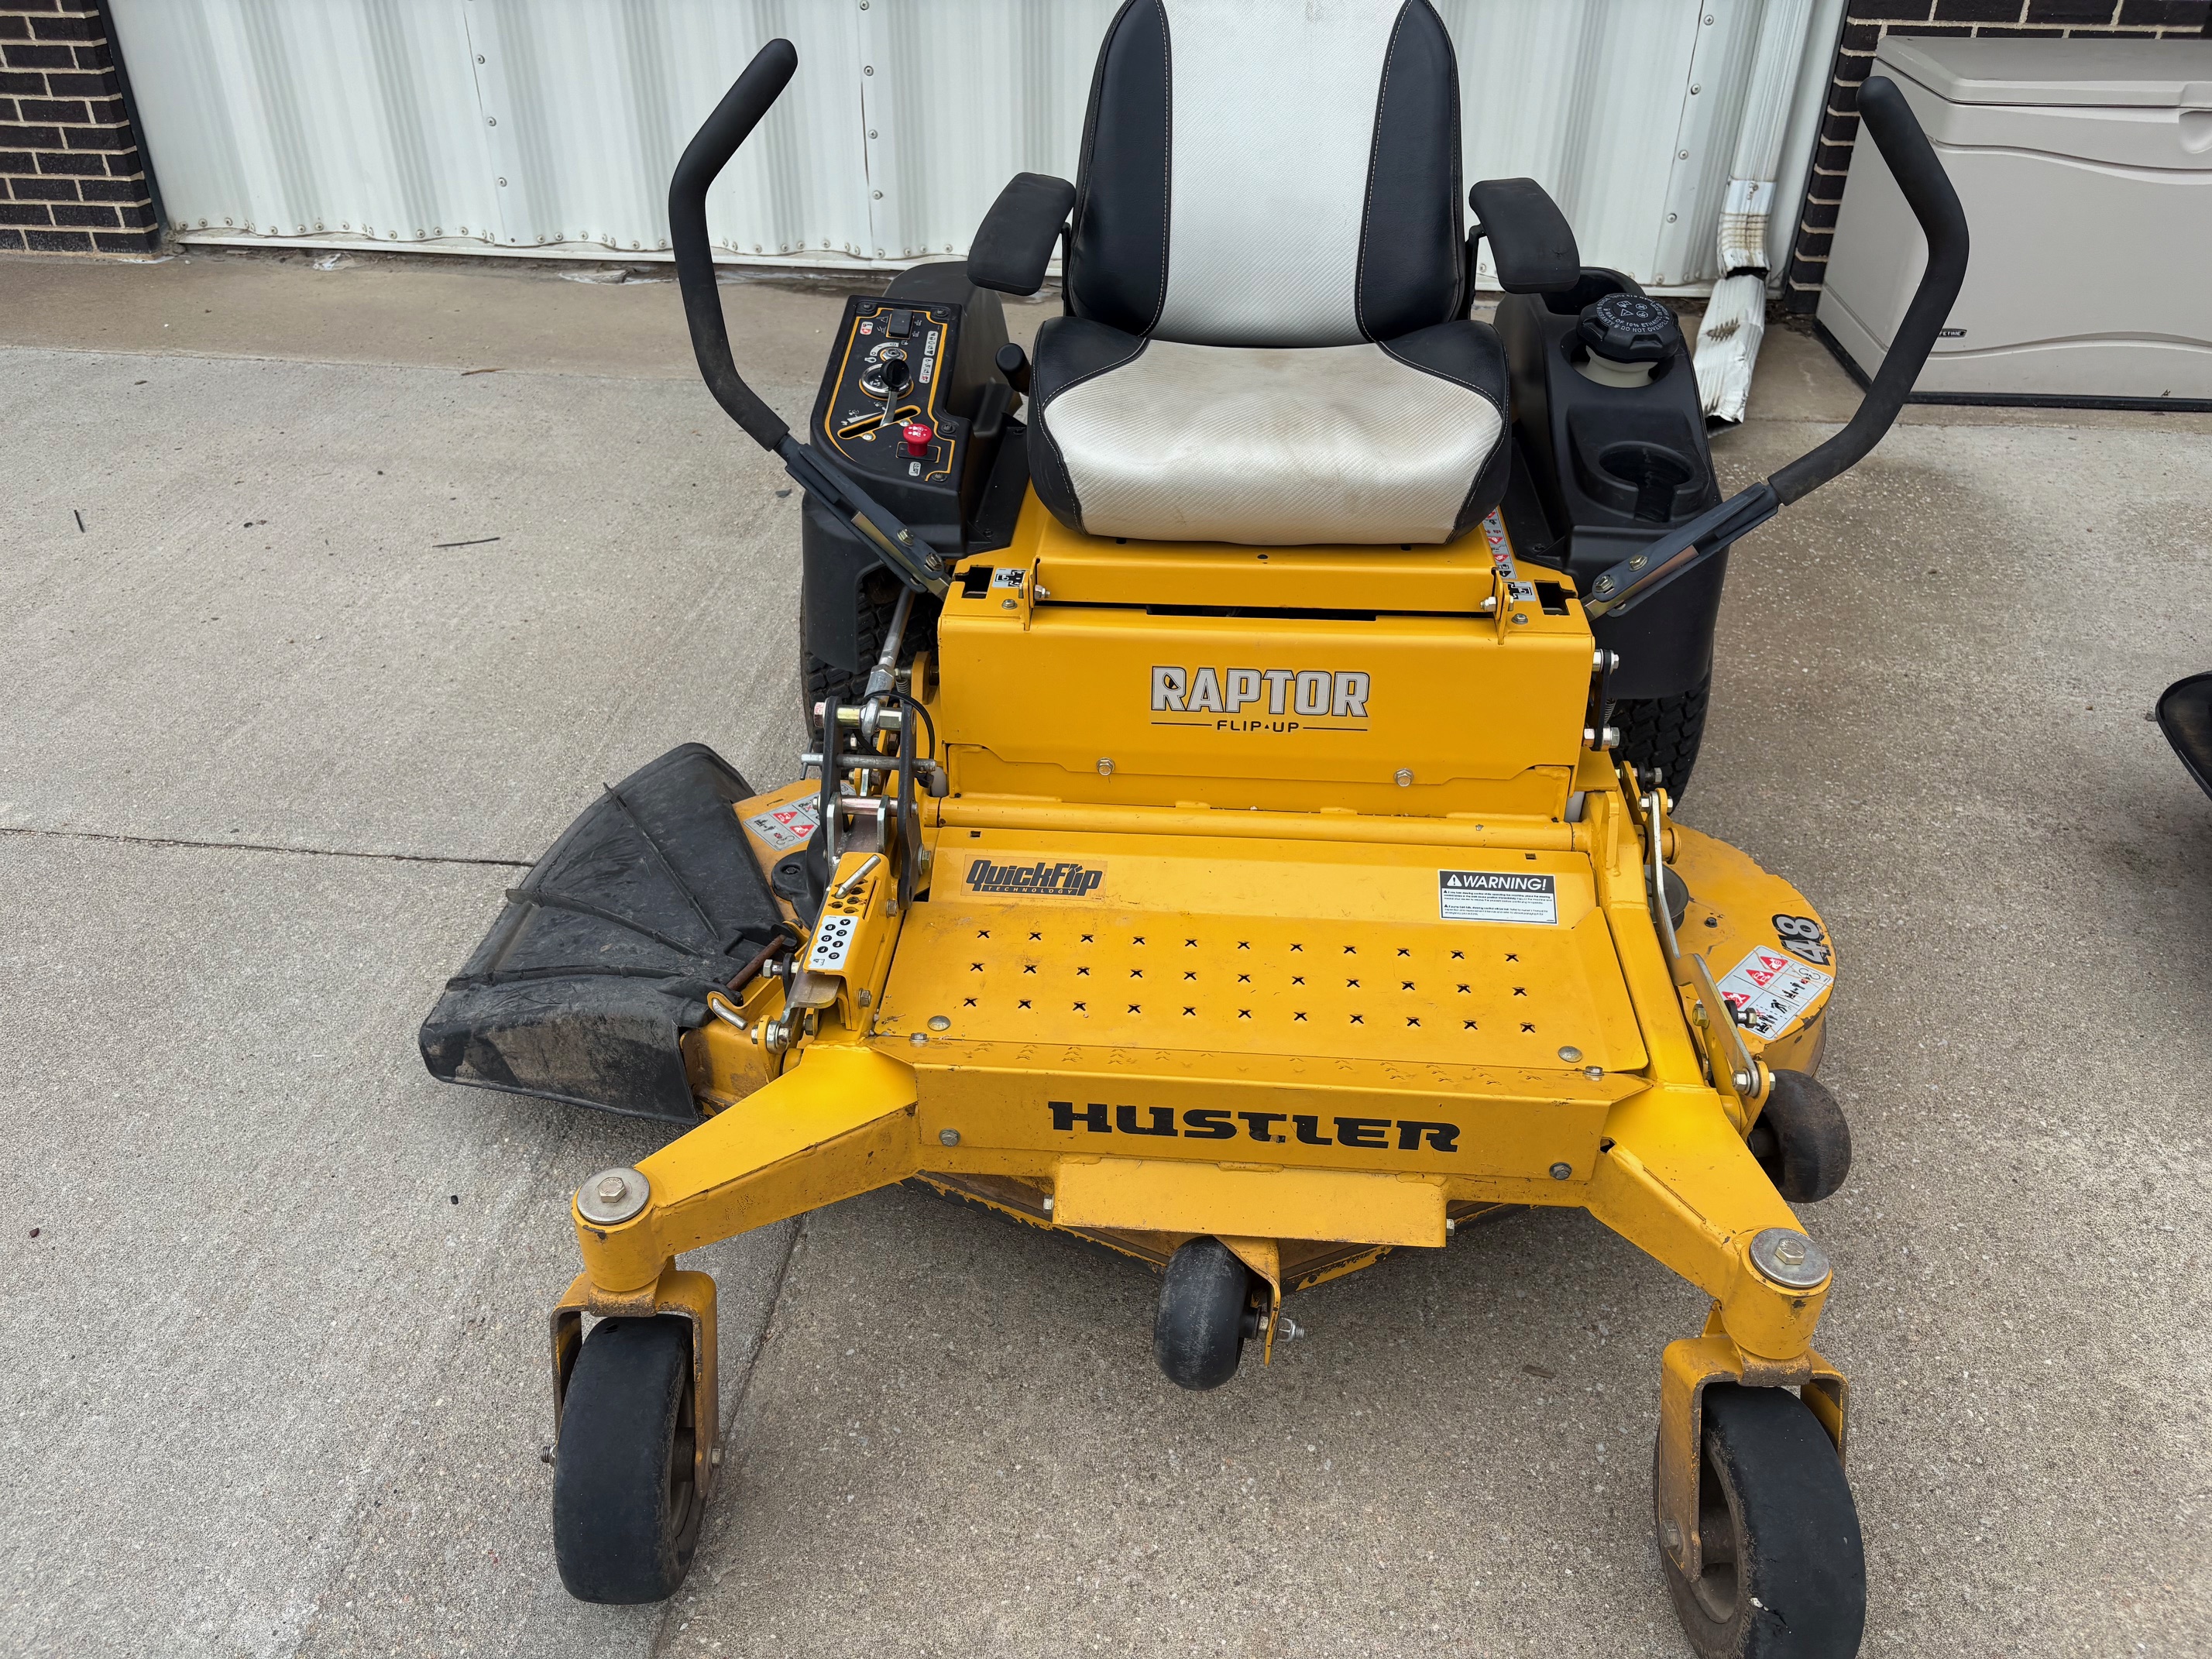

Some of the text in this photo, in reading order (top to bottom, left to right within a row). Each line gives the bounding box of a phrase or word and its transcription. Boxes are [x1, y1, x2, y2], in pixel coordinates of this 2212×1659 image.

[1605, 311, 1616, 320] MAX
[1151, 666, 1370, 717] RAPTOR
[988, 886, 1073, 895] TECHNOLOGY
[1463, 874, 1547, 891] WARNING!
[1771, 914, 1831, 967] 48
[1047, 1101, 1462, 1153] HUSTLER
